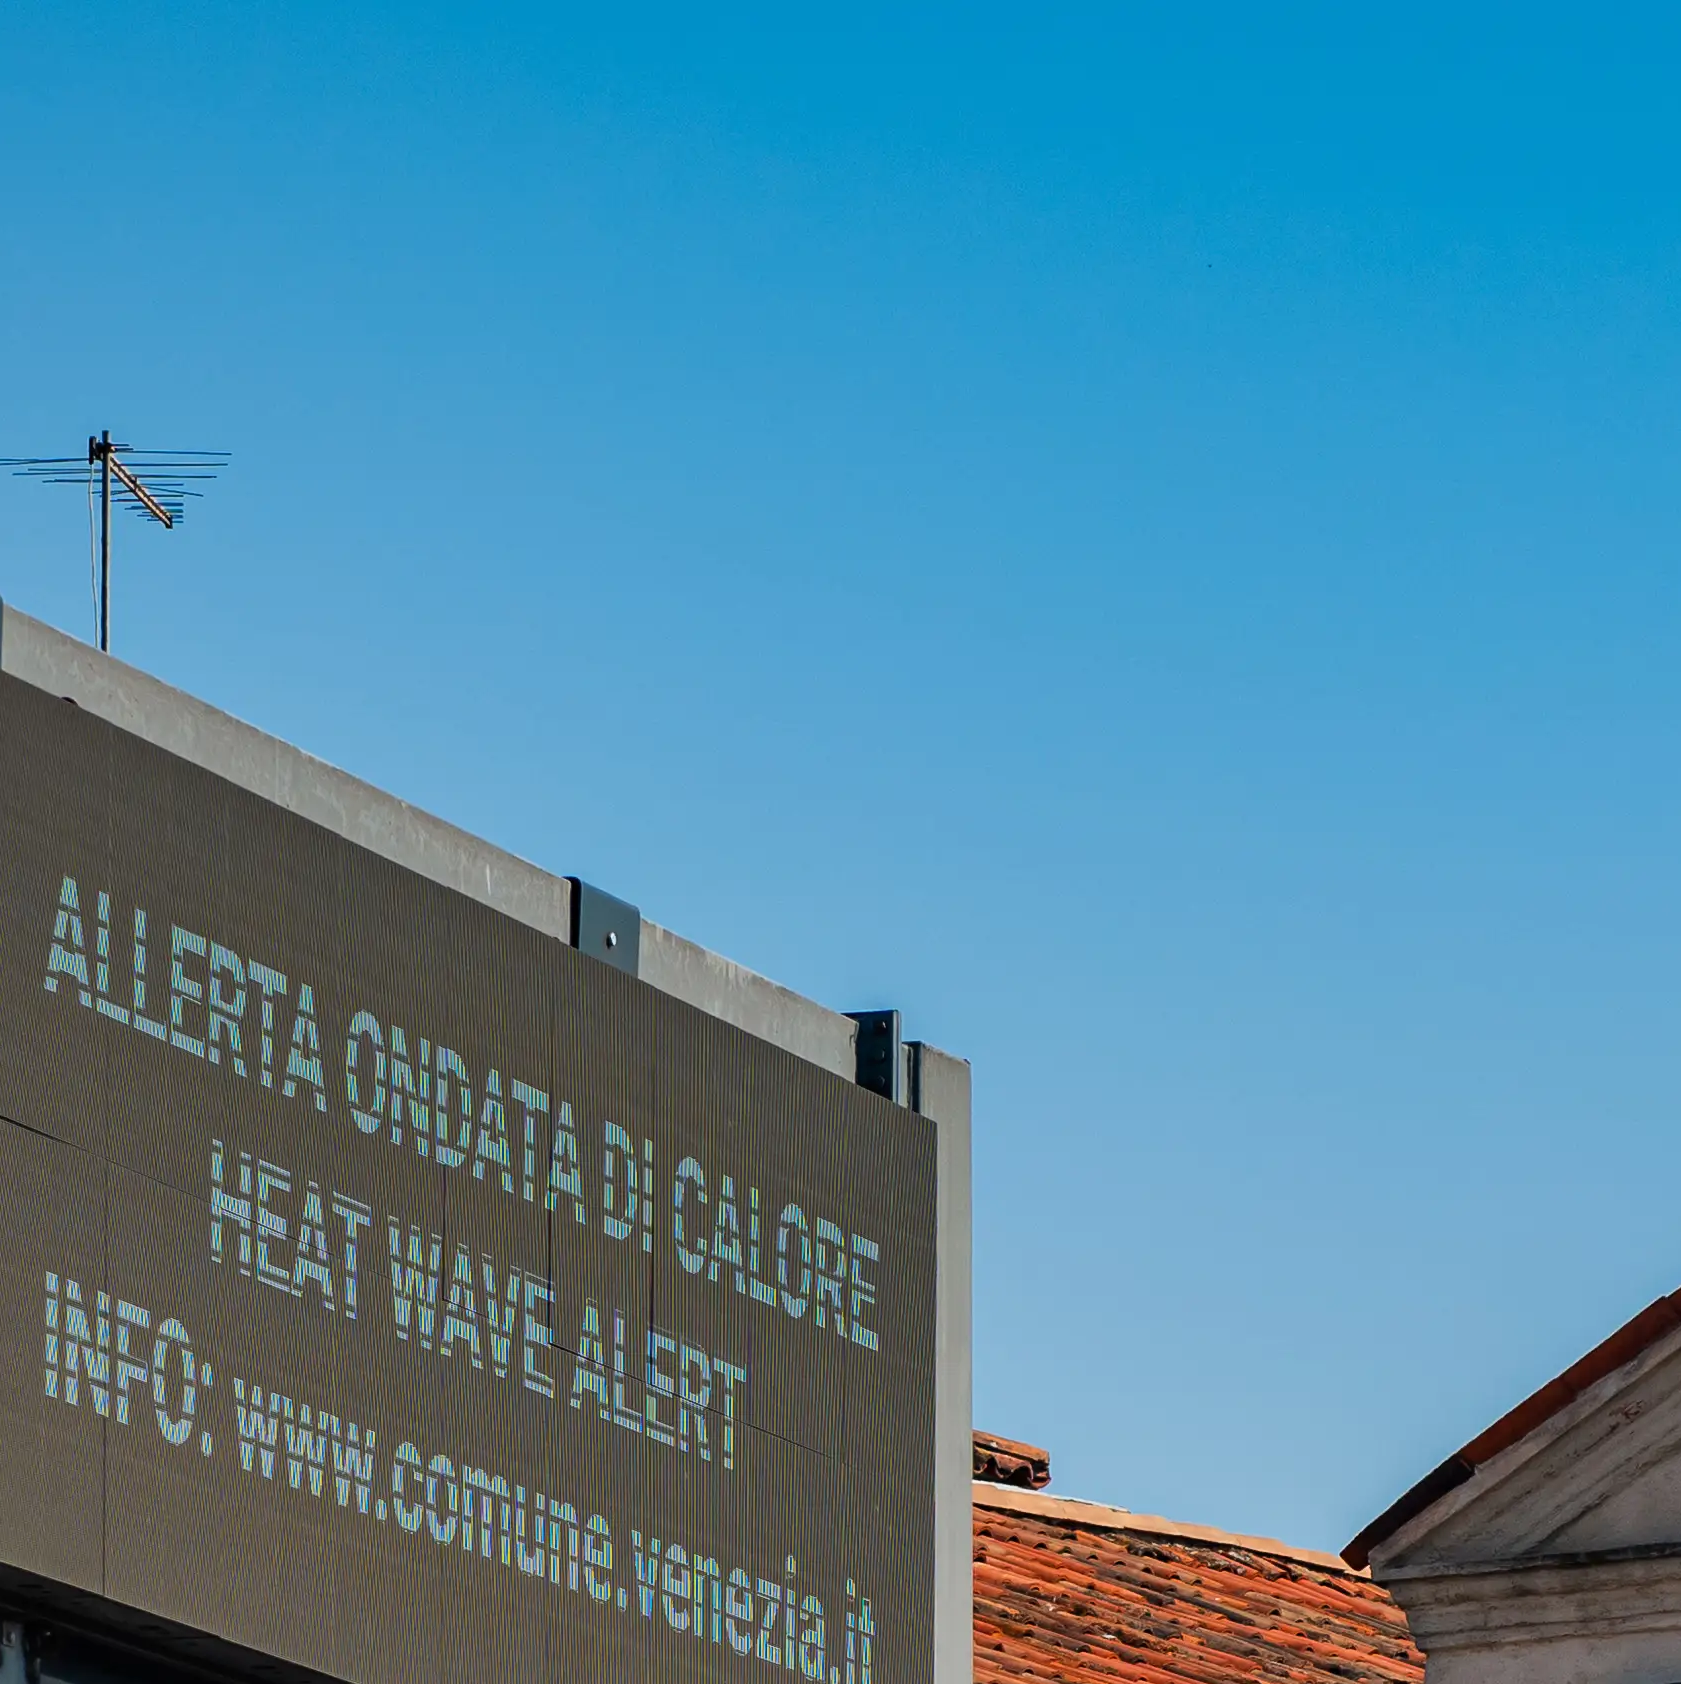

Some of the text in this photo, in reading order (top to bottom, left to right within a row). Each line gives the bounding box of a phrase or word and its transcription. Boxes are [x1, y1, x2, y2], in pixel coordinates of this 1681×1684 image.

[45, 874, 879, 1351] ALLERTA ONDATA DI CALORE
[45, 1271, 213, 1457] INFO:
[211, 1137, 746, 1471] HEAT WAVE ALERT
